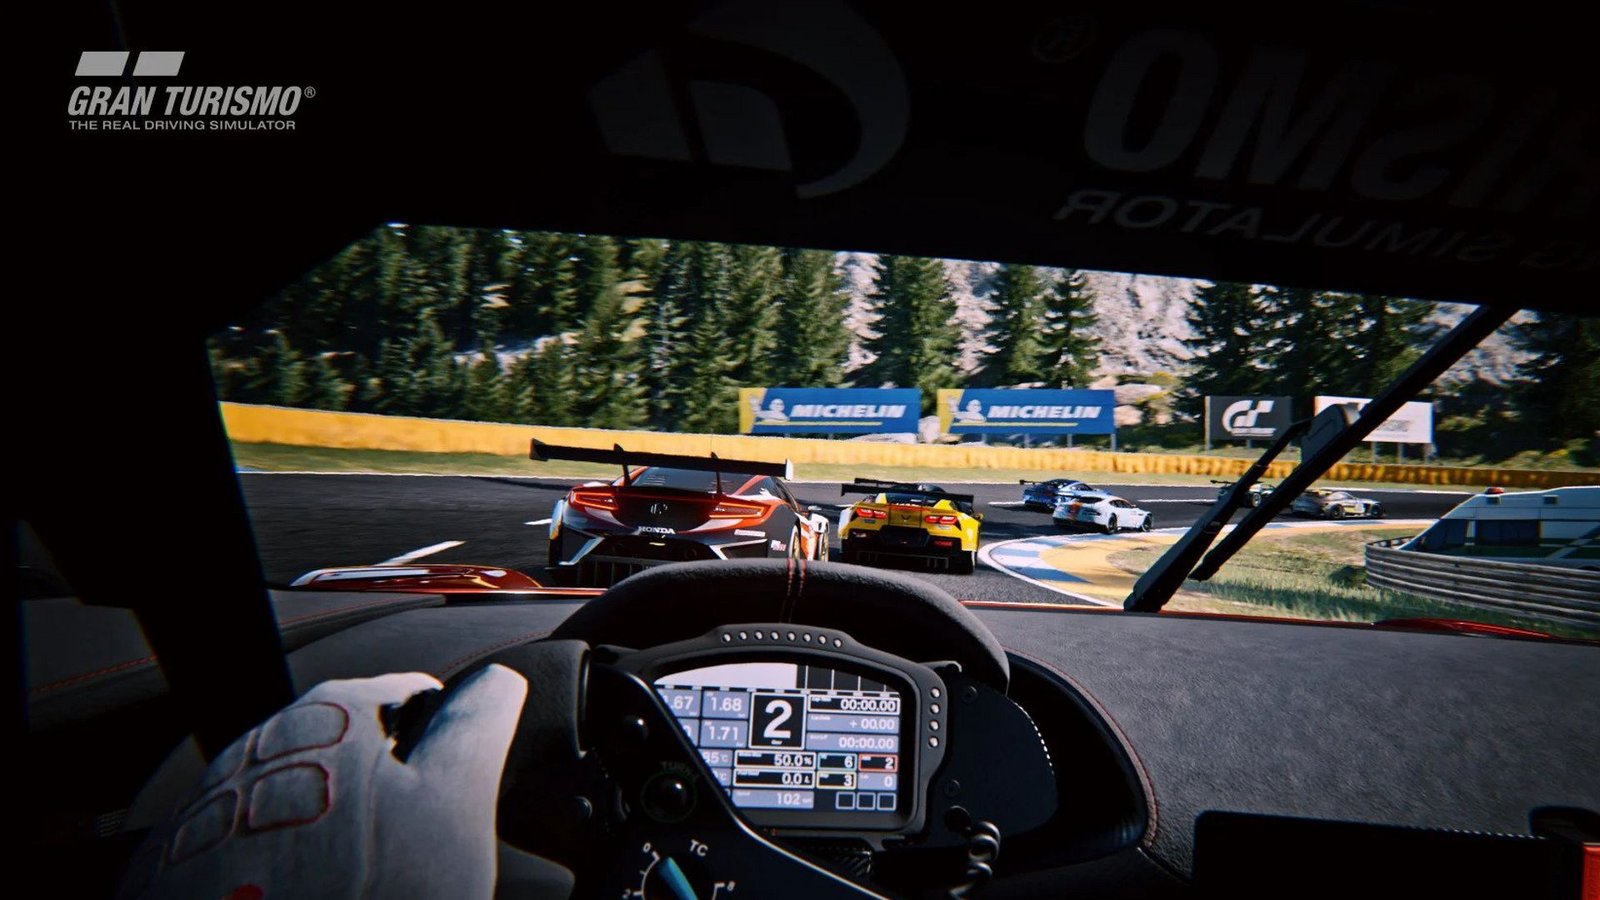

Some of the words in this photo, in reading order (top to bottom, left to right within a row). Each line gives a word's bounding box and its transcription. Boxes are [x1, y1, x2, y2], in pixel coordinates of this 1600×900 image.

[790, 404, 907, 418] MICHELIN
[987, 405, 1102, 419] MICHELIN
[638, 525, 676, 535] HONDA
[711, 697, 742, 711] 1.68
[840, 699, 896, 711] 00:00.00
[763, 699, 793, 739] 2
[860, 718, 895, 730] 00.00
[709, 726, 739, 740] 1.71
[838, 736, 895, 749] 00:00.00
[844, 756, 853, 768] 6
[884, 757, 894, 769] 2
[782, 773, 802, 786] 0.0
[843, 775, 853, 787] 3
[884, 776, 893, 787] 0
[777, 793, 801, 806] 102
[689, 839, 709, 857] TC
